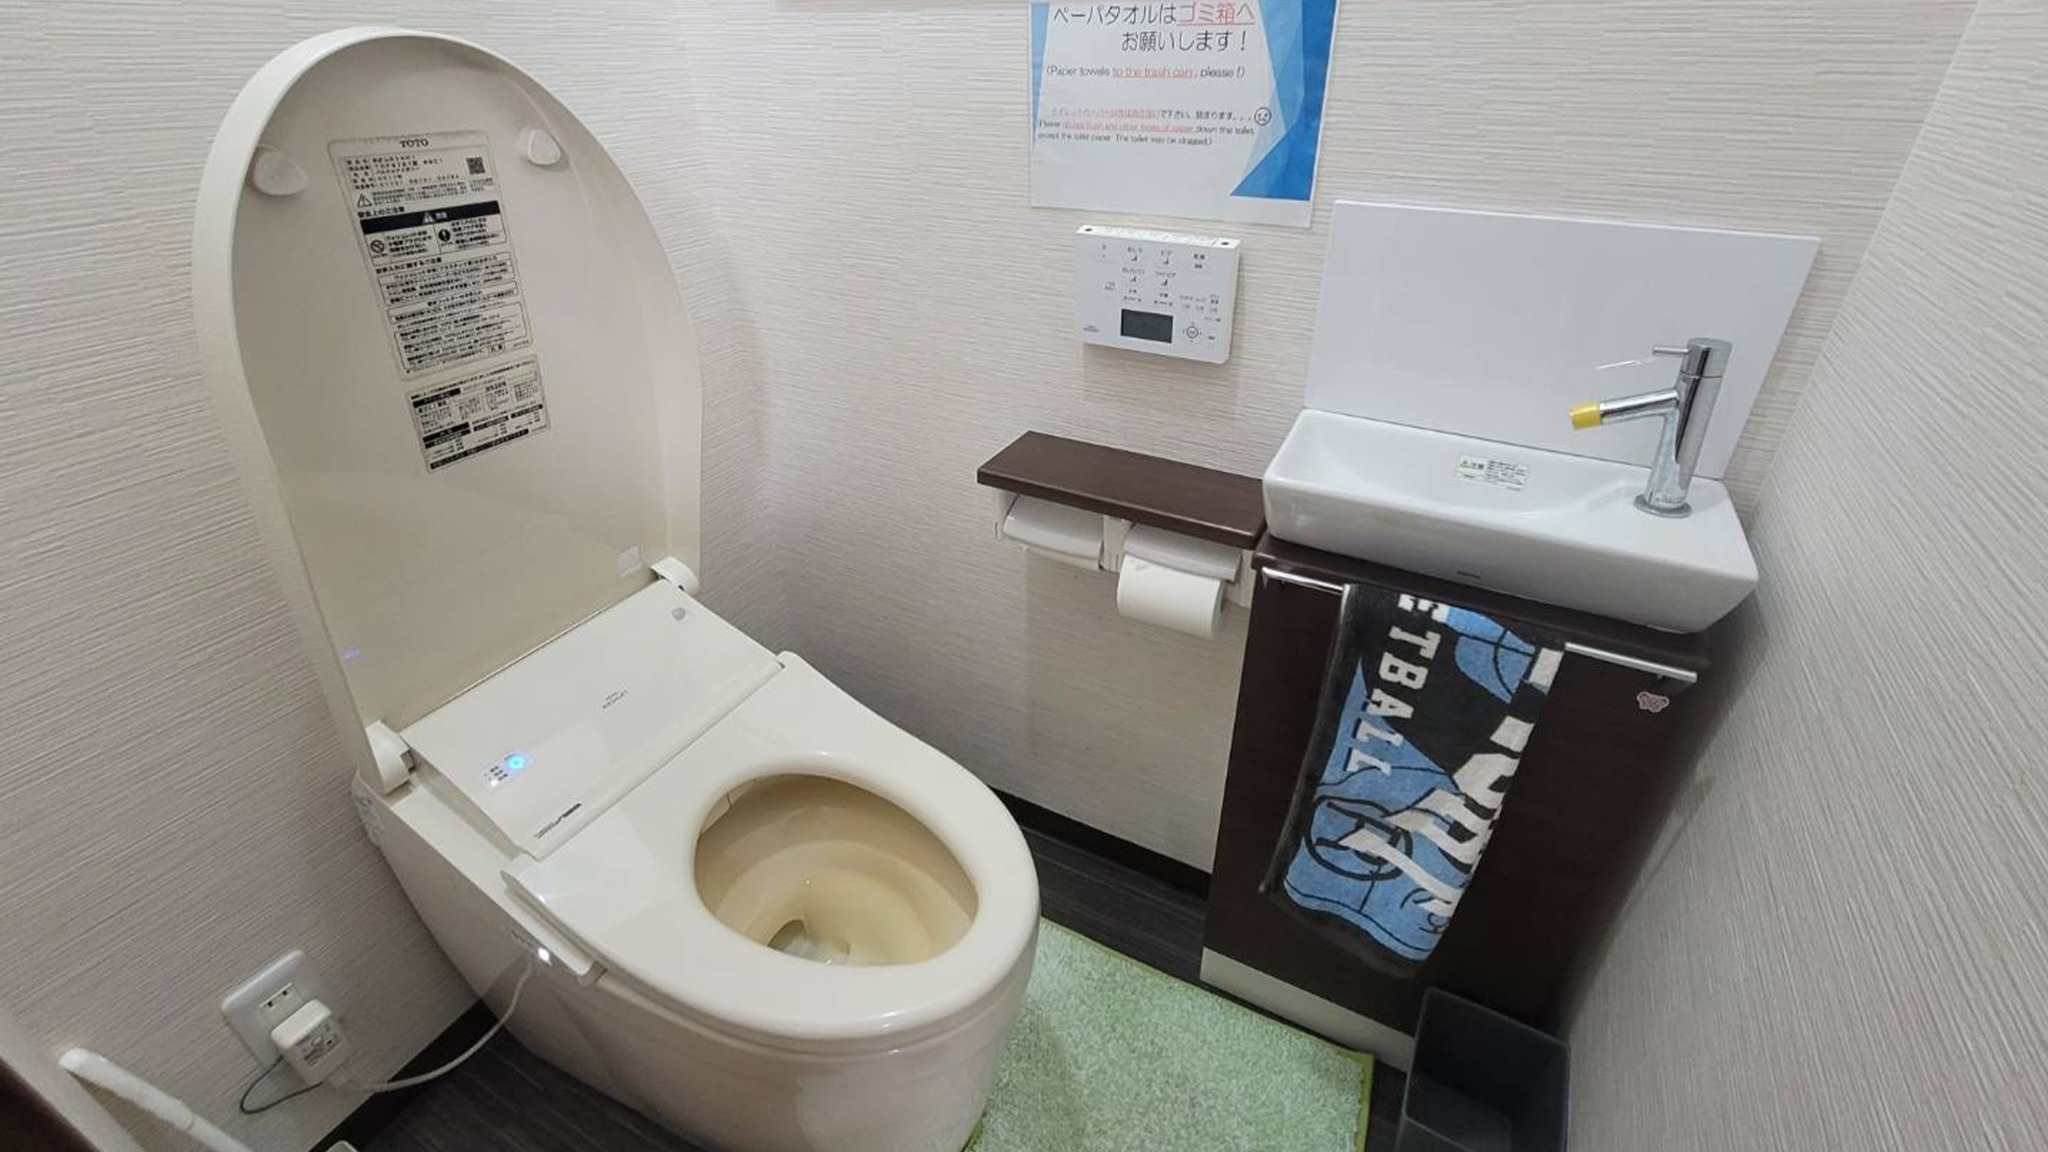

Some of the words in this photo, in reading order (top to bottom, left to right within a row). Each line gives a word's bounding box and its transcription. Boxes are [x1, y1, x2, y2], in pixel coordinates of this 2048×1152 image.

[1080, 65, 1110, 77] towels
[1125, 66, 1142, 78] the
[399, 138, 429, 148] TOTO
